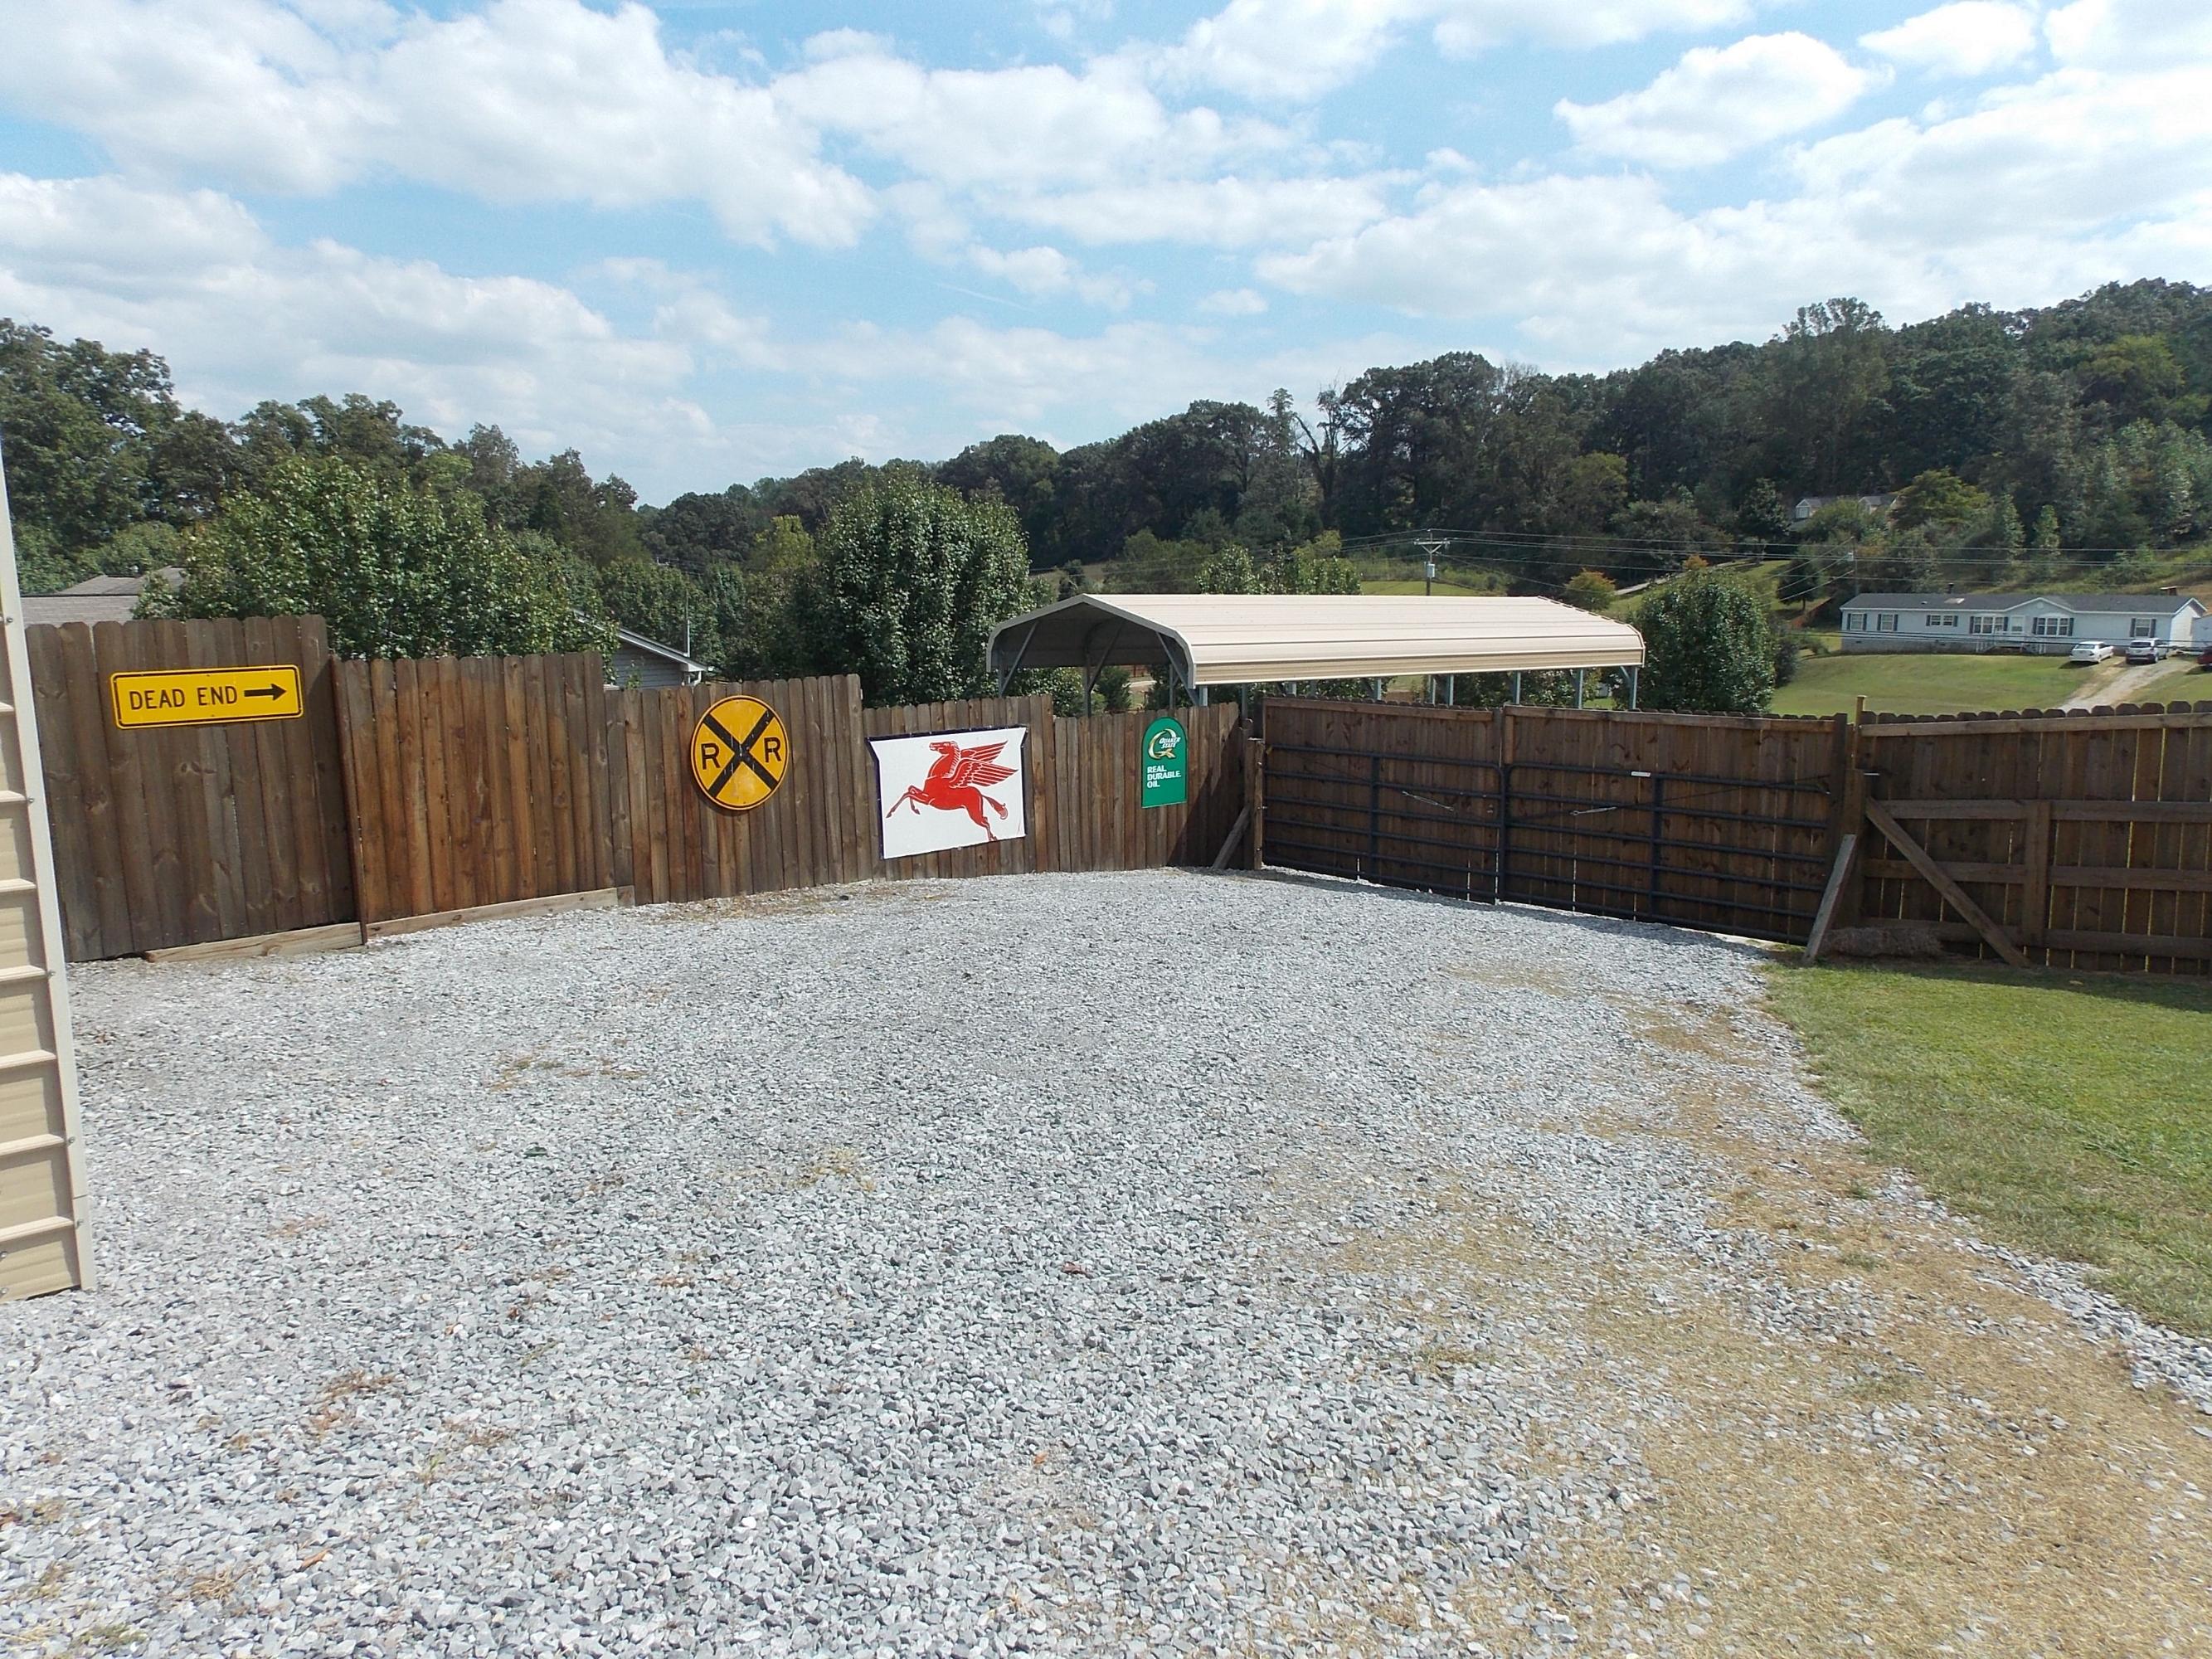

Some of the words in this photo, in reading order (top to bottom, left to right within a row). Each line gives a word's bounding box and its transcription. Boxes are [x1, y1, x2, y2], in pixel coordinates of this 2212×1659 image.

[129, 688, 186, 710] DEAD
[197, 685, 238, 706] END
[701, 743, 721, 770] R
[764, 737, 781, 762] R
